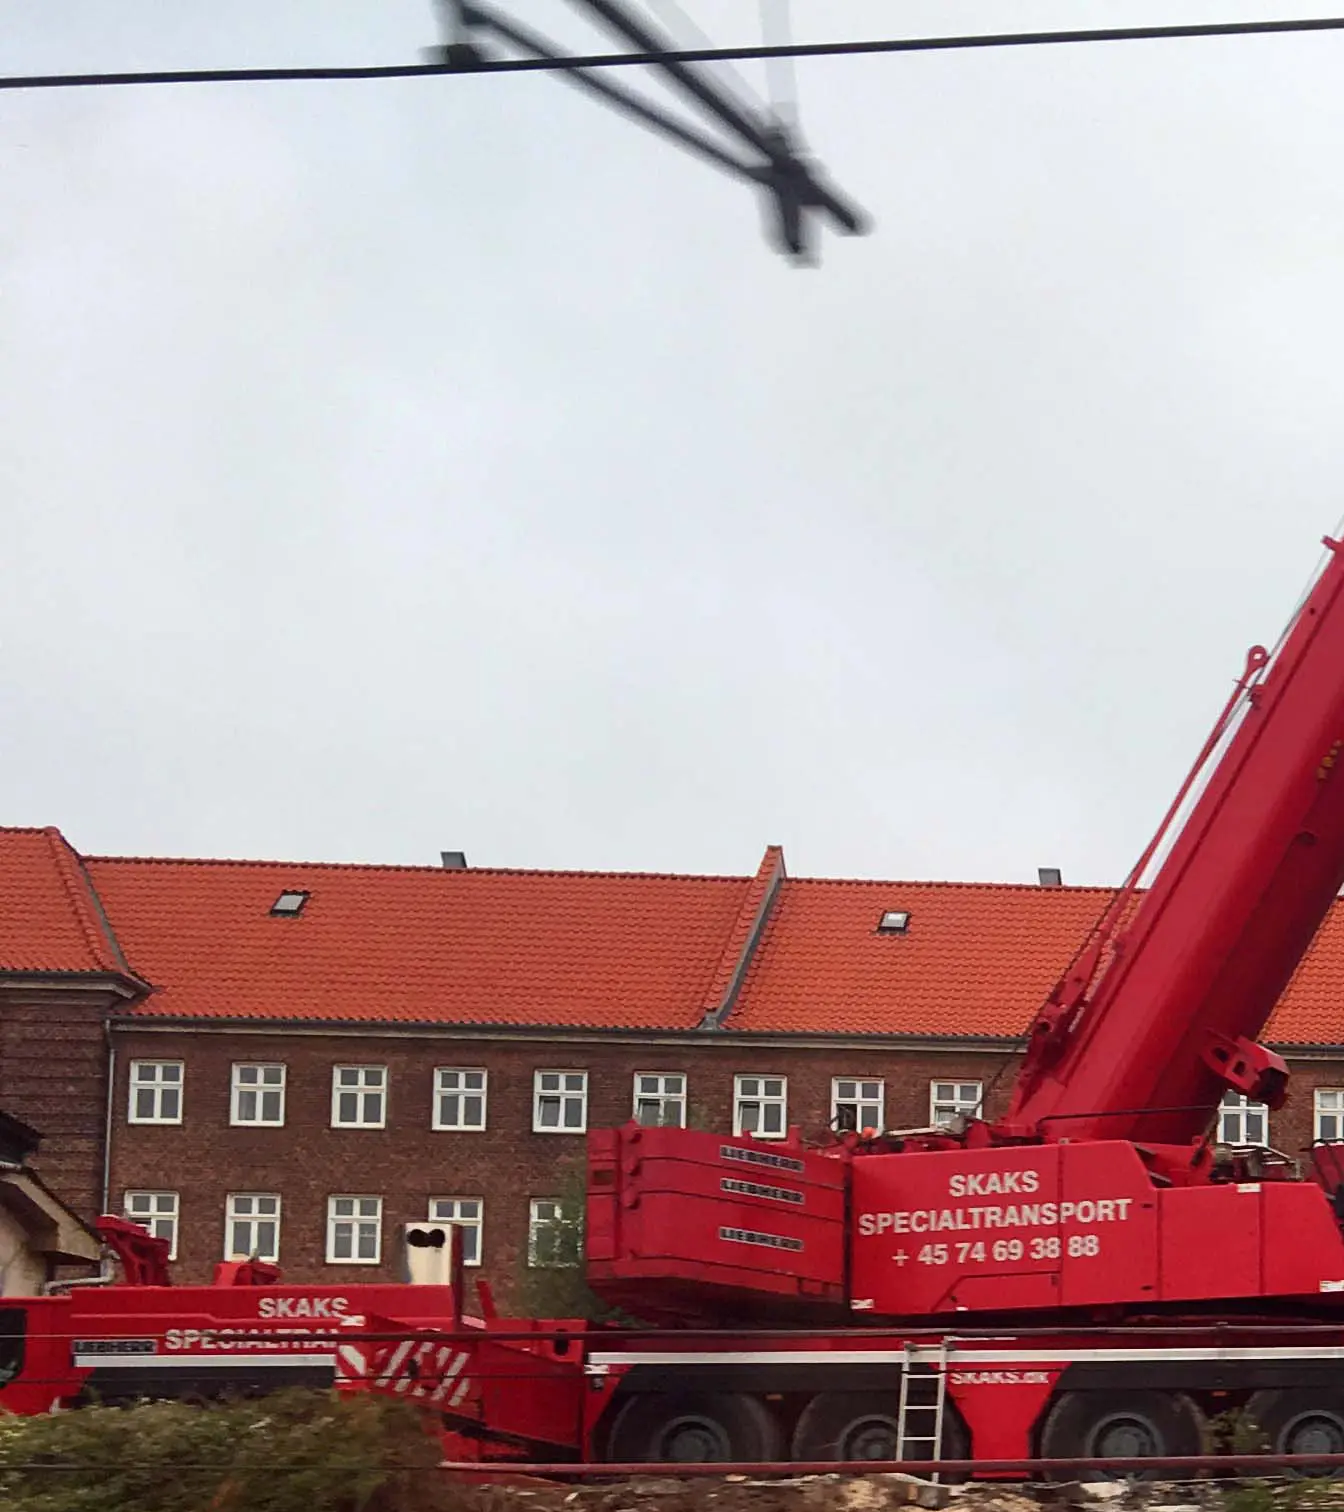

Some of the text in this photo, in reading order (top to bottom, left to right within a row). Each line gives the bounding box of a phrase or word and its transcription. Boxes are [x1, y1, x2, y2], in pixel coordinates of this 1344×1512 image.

[949, 1170, 1039, 1197] SKAKS
[859, 1199, 1132, 1235] SPECIALTRANSPORT
[917, 1243, 948, 1265] 45
[955, 1241, 986, 1263] 74
[992, 1239, 1022, 1261] 69
[1030, 1237, 1061, 1259] 38
[1068, 1235, 1099, 1257] 88
[258, 1297, 350, 1319] SKAKS
